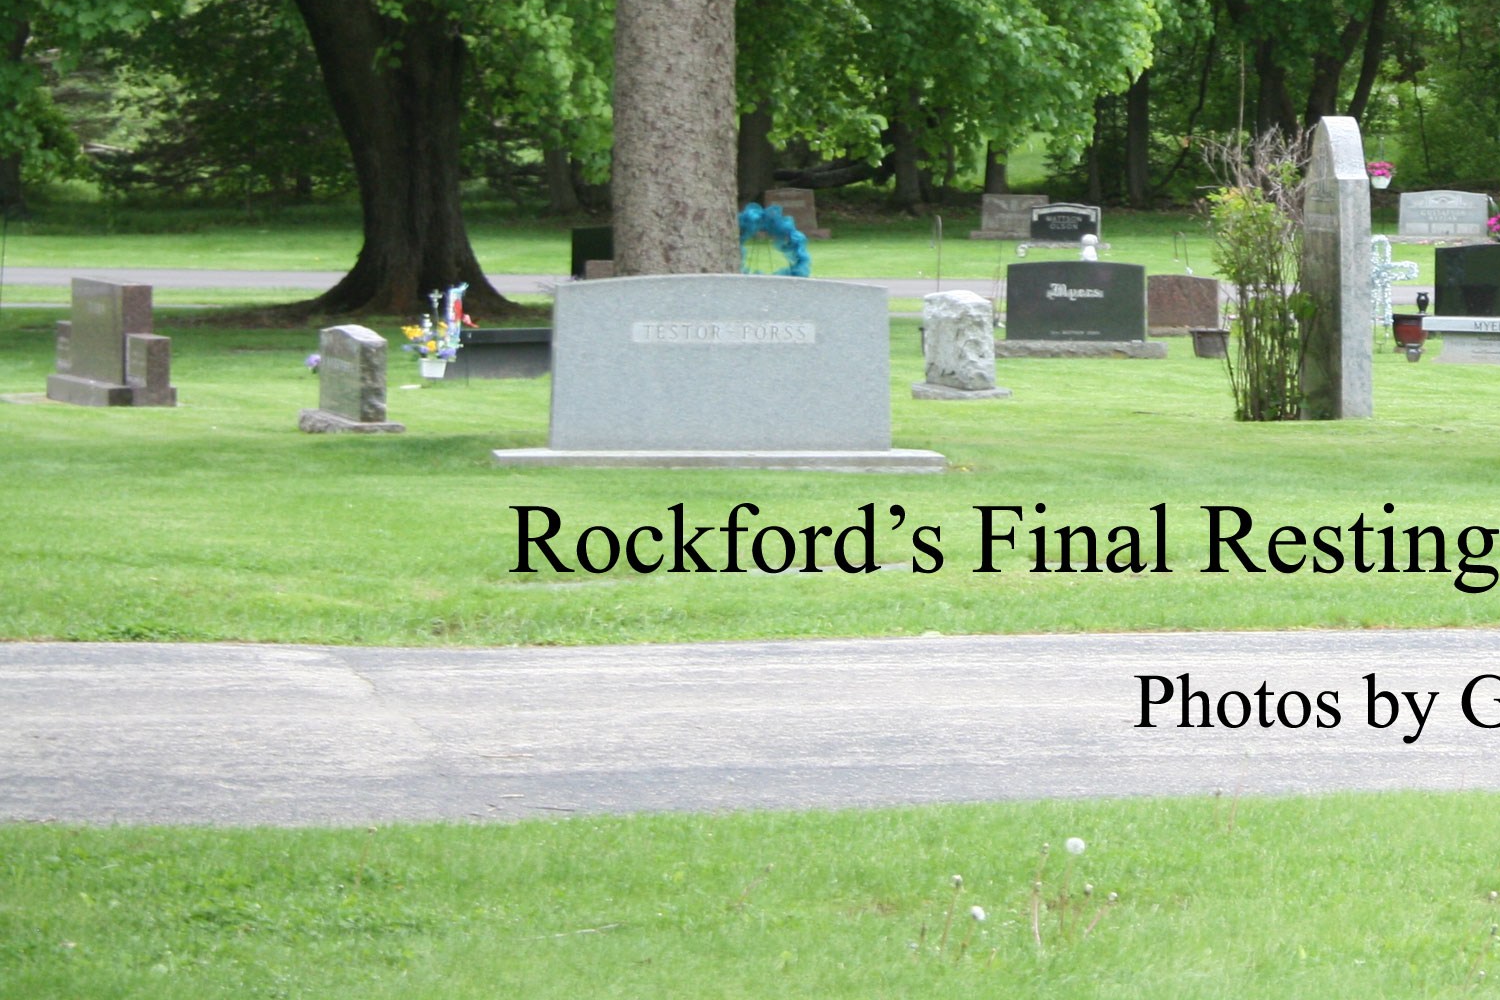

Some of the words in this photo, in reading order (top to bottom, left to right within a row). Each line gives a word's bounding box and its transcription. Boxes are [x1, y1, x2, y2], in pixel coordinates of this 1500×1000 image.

[1046, 282, 1104, 301] Myers
[642, 323, 722, 341] TESTOR
[742, 325, 807, 341] FORSS
